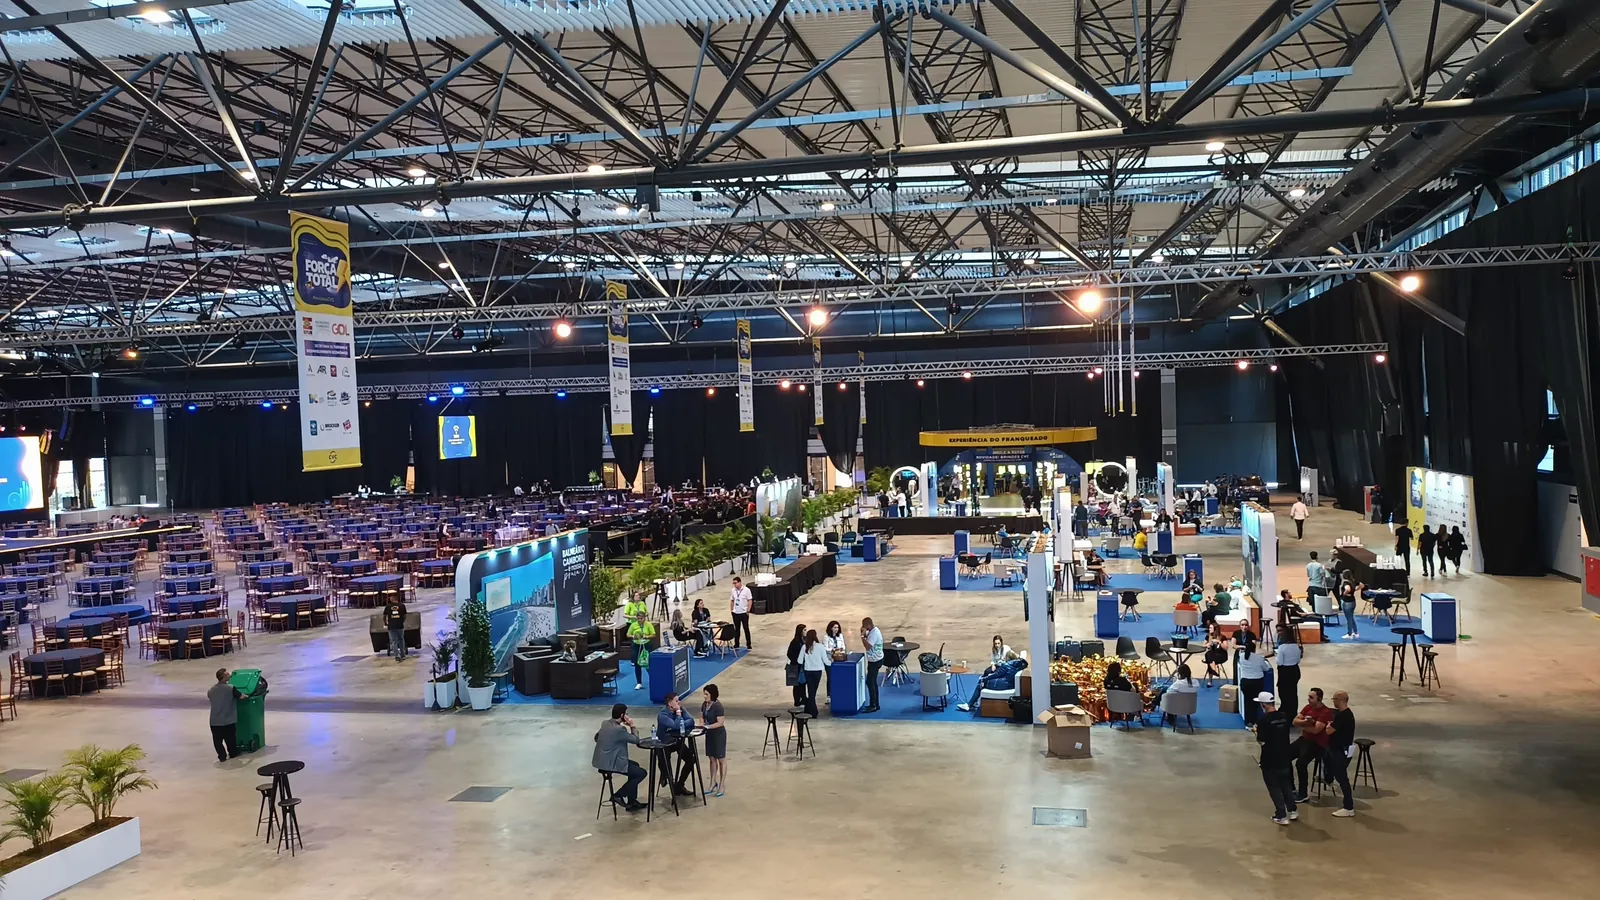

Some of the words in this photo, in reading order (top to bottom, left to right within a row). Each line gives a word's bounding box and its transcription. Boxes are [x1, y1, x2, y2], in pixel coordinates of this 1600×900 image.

[305, 259, 337, 276] FORÇA
[305, 272, 339, 288] TOTAL
[331, 323, 350, 336] GOL
[562, 545, 585, 558] BALNEÁRIO
